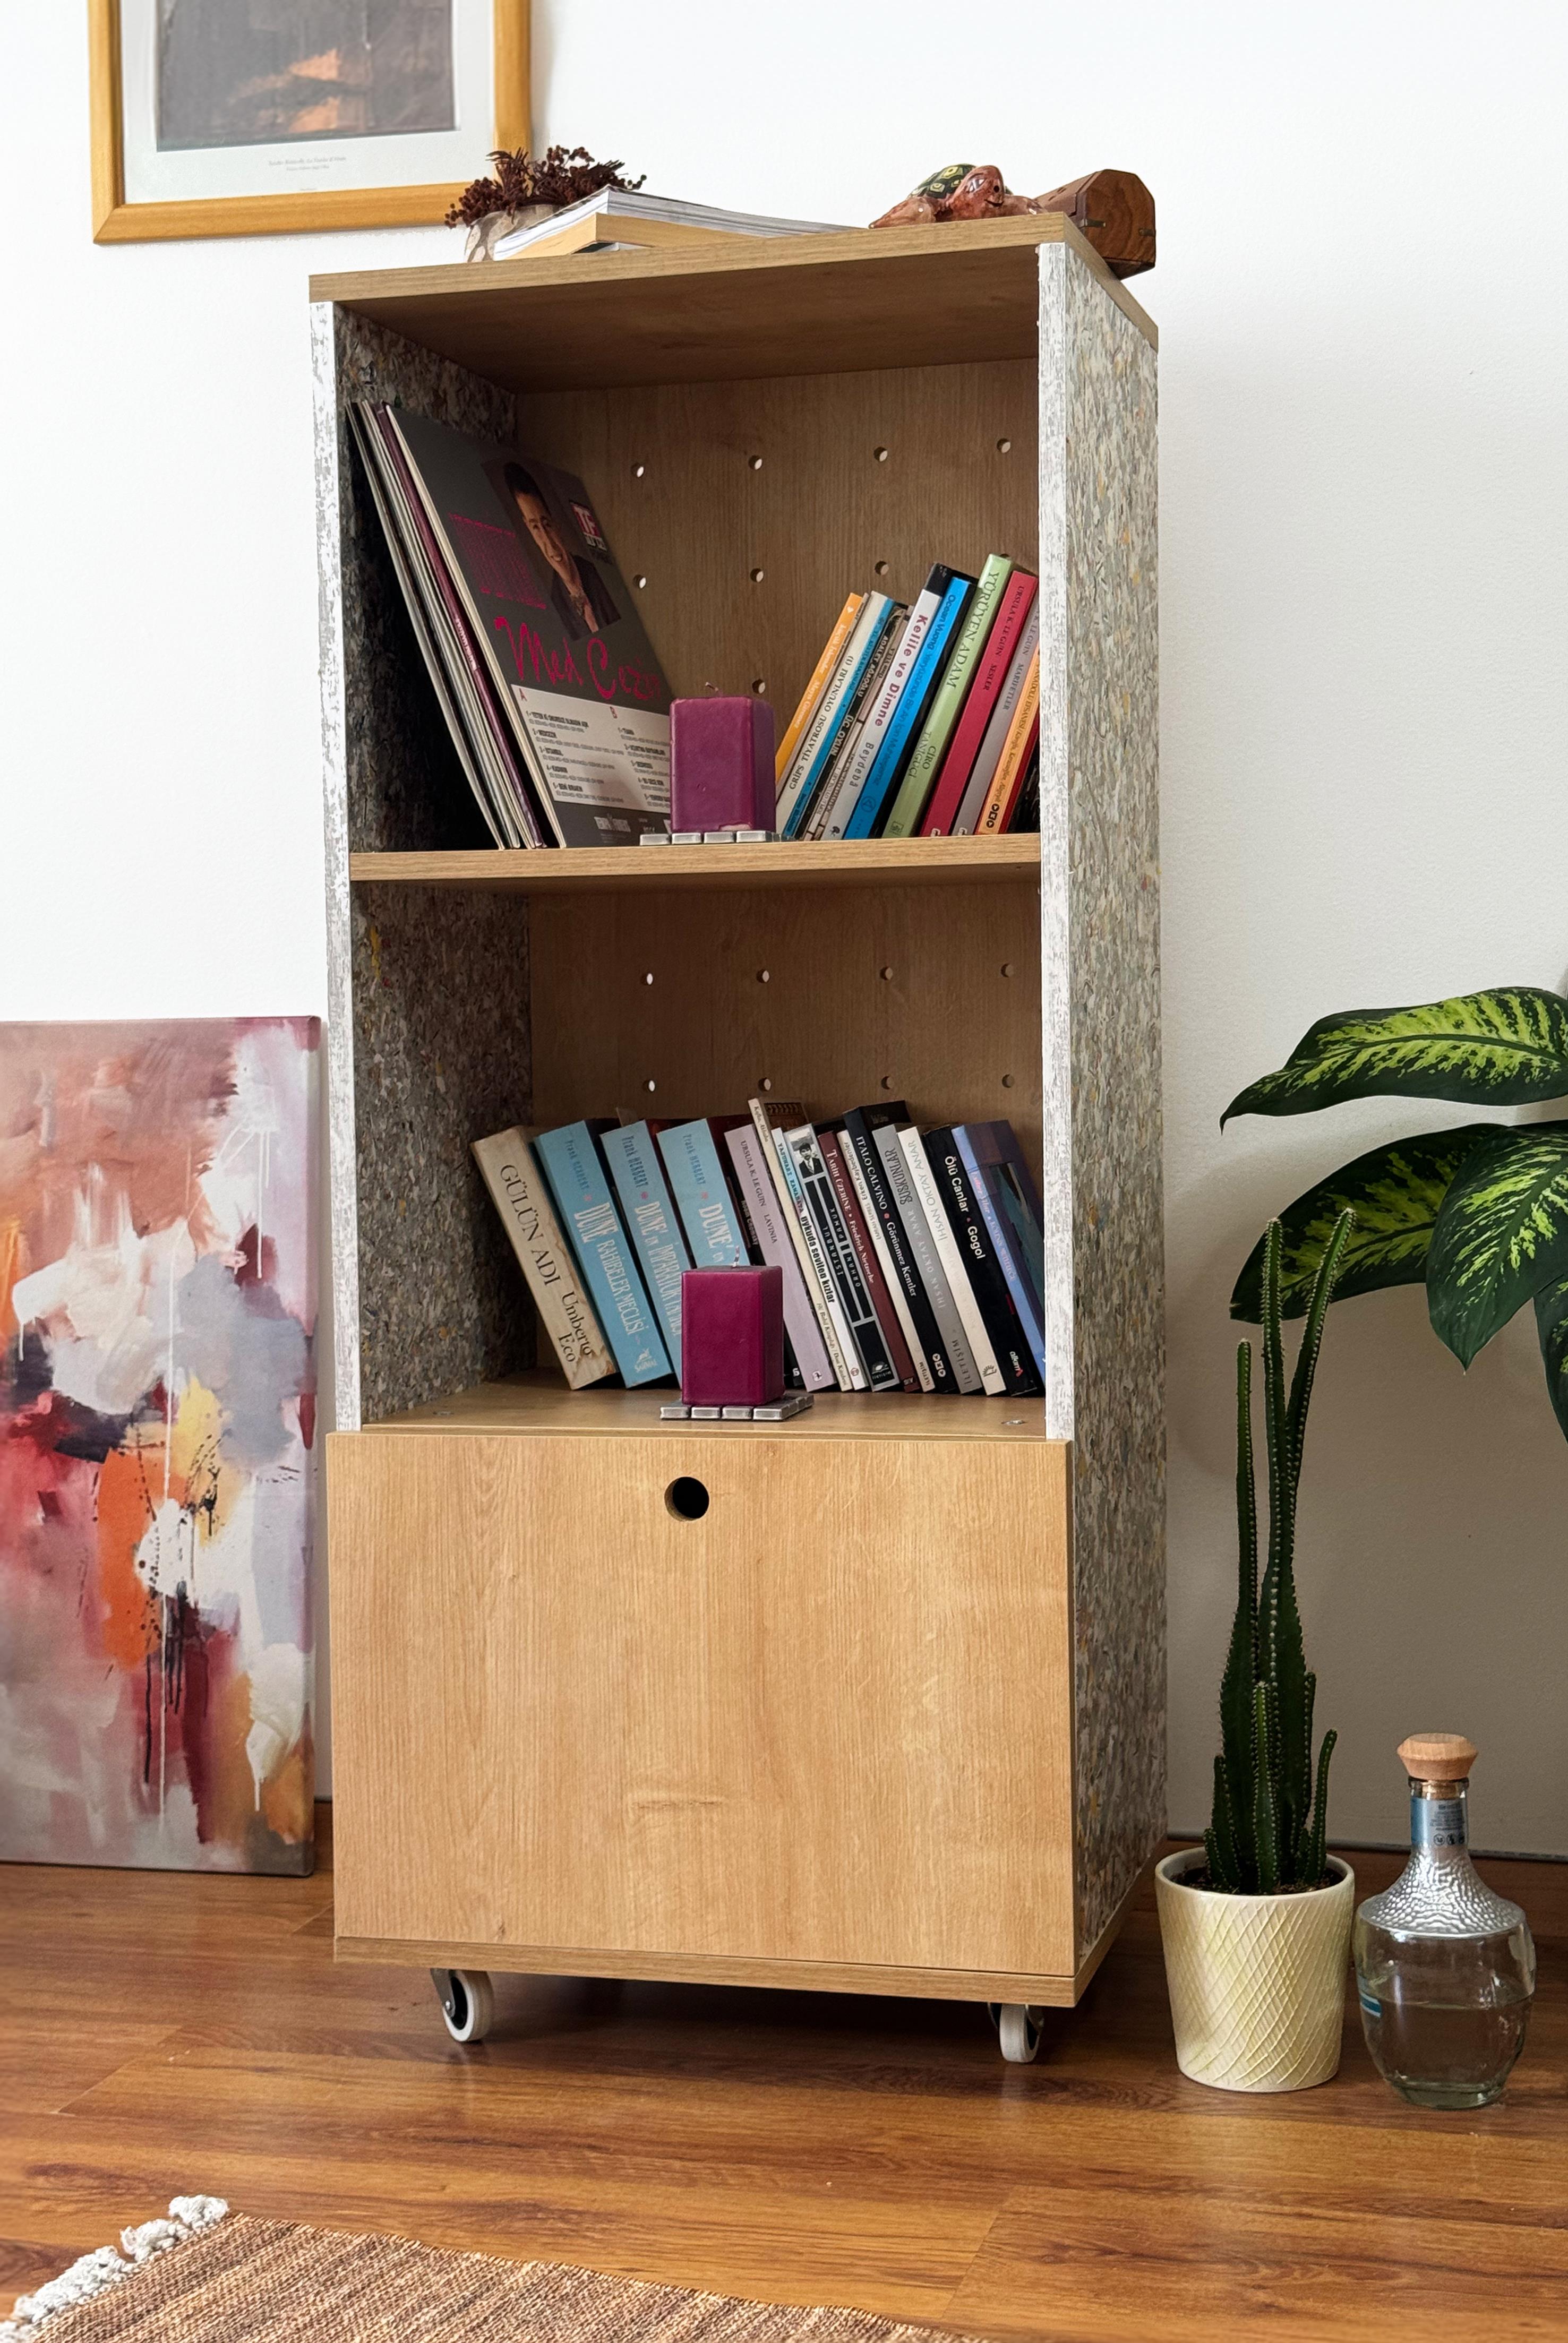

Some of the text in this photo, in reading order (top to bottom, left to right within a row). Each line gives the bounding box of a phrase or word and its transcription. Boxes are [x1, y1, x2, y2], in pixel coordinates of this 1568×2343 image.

[1008, 585, 1024, 616] URSULA
[927, 593, 957, 651] Ocean Vuong
[947, 572, 999, 688] YÜRÜYEN ADAM
[1001, 625, 1010, 636] LE
[994, 634, 1007, 656] GUIN
[1021, 634, 1034, 655] GUIN
[856, 634, 889, 698] ADALET AĞAOĞLU
[875, 615, 928, 726] Kelile ve Dimne
[788, 764, 804, 790] GRİPS
[801, 716, 827, 761] TİYATROSU
[825, 668, 847, 712] OYUNLARI
[830, 729, 846, 757] OYUN
[741, 1140, 755, 1168] URSULA
[842, 1140, 862, 1181] Kaybedenler
[856, 1136, 887, 1209] ITALO CALVINO
[908, 1140, 924, 1170] ANAR
[751, 1177, 760, 1187] LE
[754, 1187, 767, 1207] GUIN
[857, 1181, 868, 1201] Erken
[885, 1149, 912, 1205] SUSKUNLAR
[919, 1174, 936, 1206] OKTAY
[945, 1155, 968, 1212] Ölü Canlar
[500, 1165, 560, 1285] GÜLÜN ADI
[907, 1209, 921, 1235] ANAR
[967, 1226, 985, 1259] Gogol
[574, 1201, 648, 1334] DUNE RAHİBELER MECLİSİ
[799, 1215, 837, 1304] uykuda sevilen kızlar
[830, 1208, 861, 1287] ORHAN PAMUK
[849, 1220, 875, 1283] Friedrich Nietzsche
[887, 1222, 917, 1295] Görünmez Kentler
[919, 1241, 934, 1273] OKTAY
[562, 1292, 595, 1356] Umberto
[558, 1333, 580, 1362] Eco
